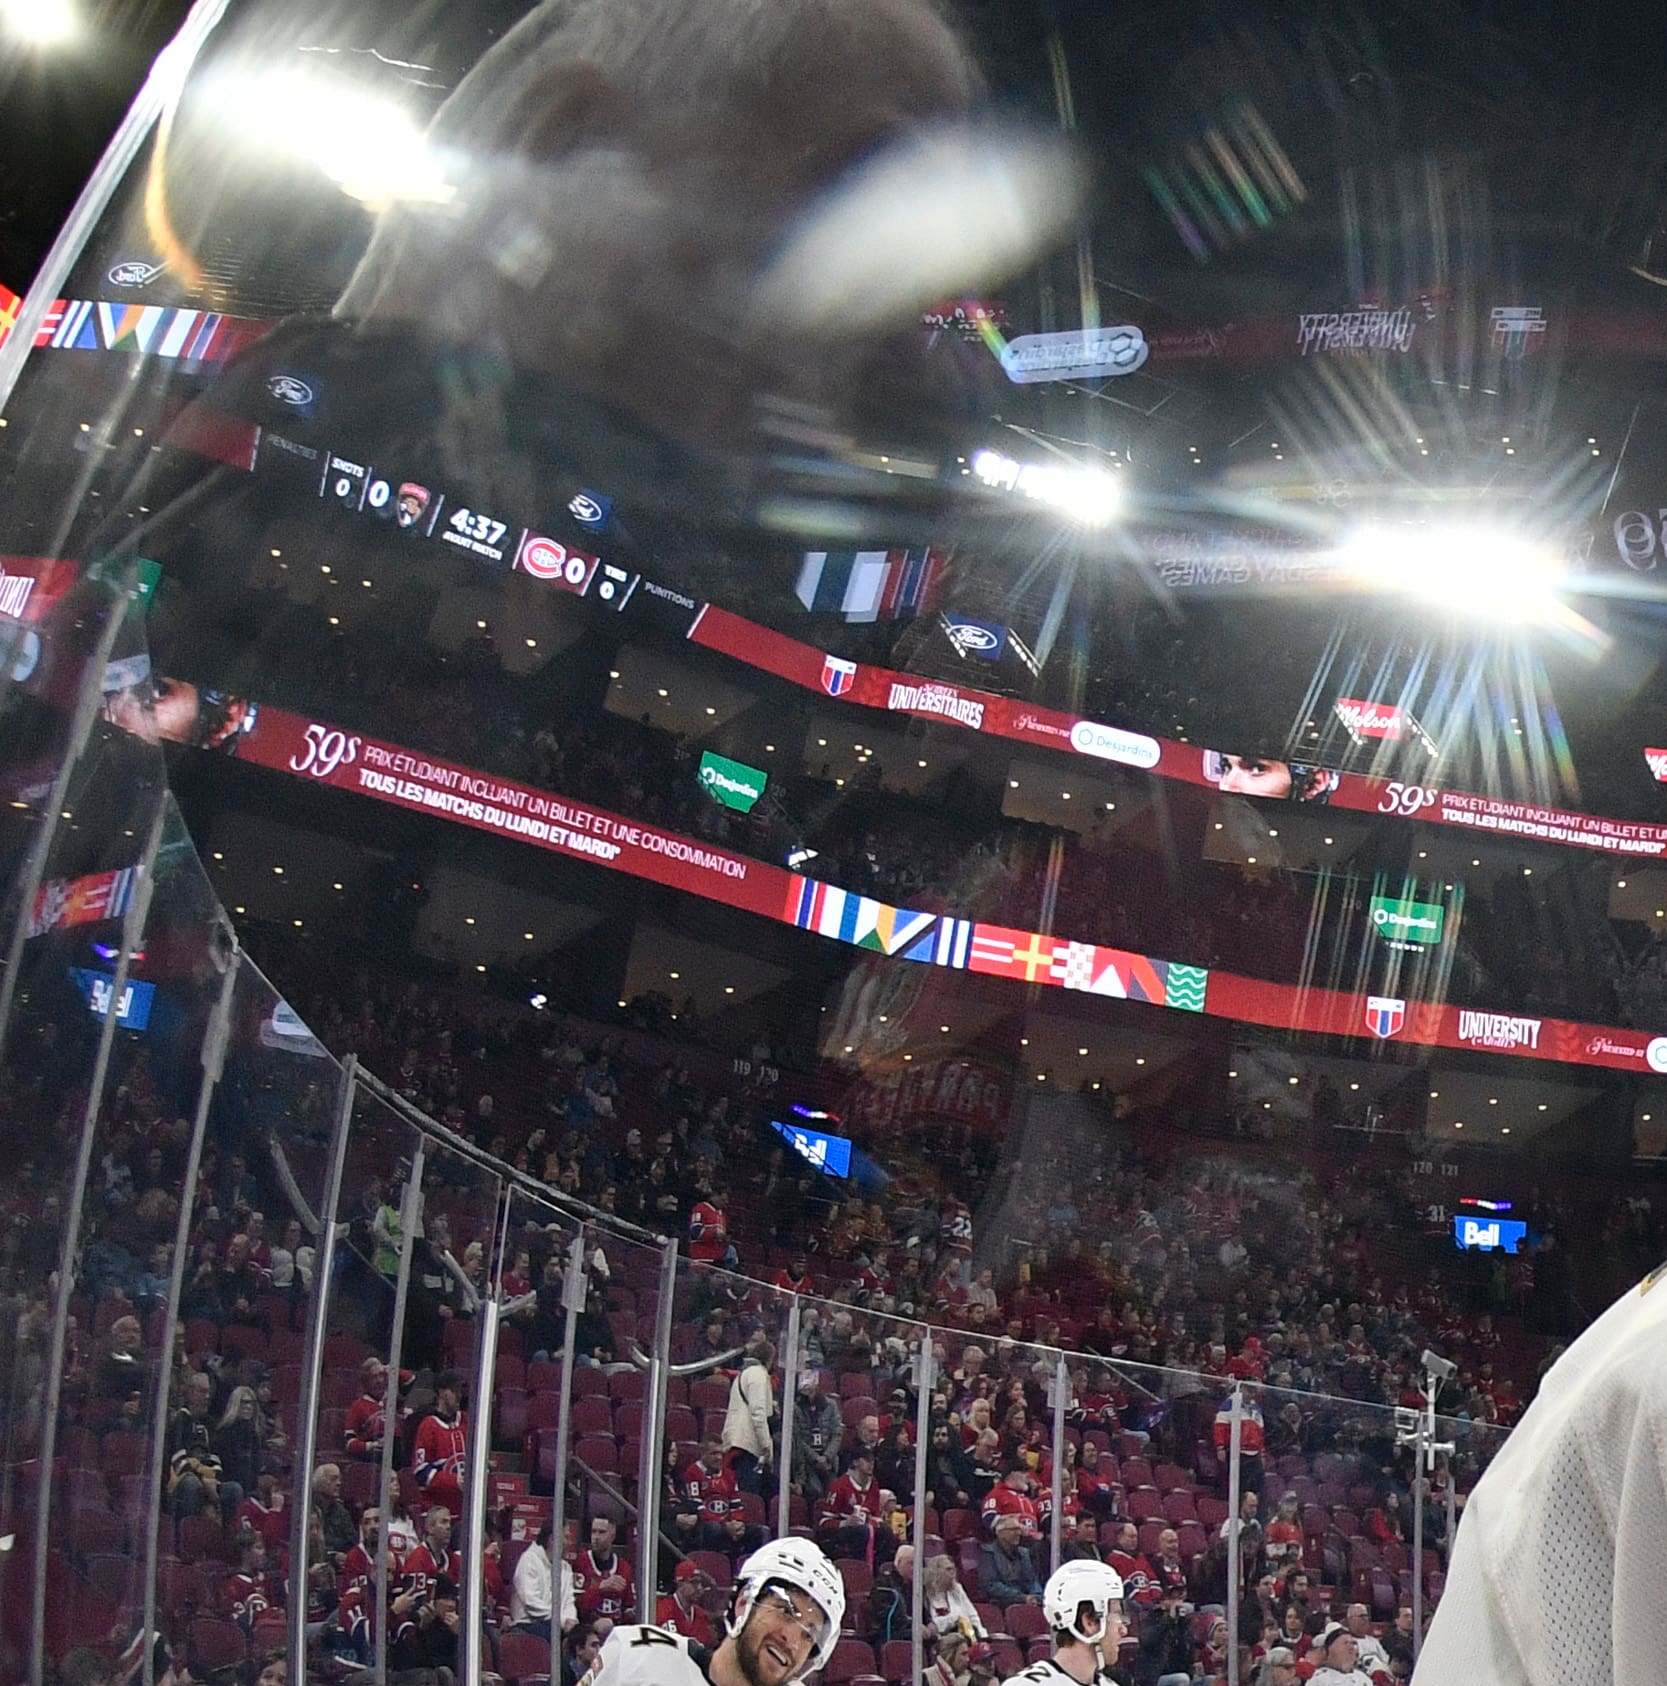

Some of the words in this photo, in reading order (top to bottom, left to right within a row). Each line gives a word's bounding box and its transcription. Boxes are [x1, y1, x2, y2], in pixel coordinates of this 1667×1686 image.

[331, 457, 364, 477] SHOTS
[335, 479, 350, 497] 0
[369, 481, 390, 507] 0
[450, 508, 508, 545] 4:37
[565, 557, 586, 584] 0
[600, 581, 615, 600] 0
[644, 581, 695, 609] PUNITIONS
[888, 683, 985, 730] UNIVERSITAIRES
[1096, 735, 1153, 759] Desjardins
[359, 768, 396, 793] TOUS
[396, 782, 425, 803] LES
[424, 788, 485, 820] MATCHS
[484, 806, 507, 826] DU
[506, 812, 549, 841] LUNDI
[547, 826, 569, 846] ET
[364, 745, 393, 769] PRIX
[460, 776, 527, 808] INCLUANT
[528, 797, 551, 817] UN
[550, 802, 595, 831] BILLET
[593, 817, 612, 835] ET
[613, 823, 642, 846] UNE
[641, 832, 748, 879] CONSOMMATION
[1442, 794, 1469, 809] PRIX
[1526, 806, 1583, 828] INCLUANT
[1583, 818, 1600, 832] UN
[1600, 821, 1639, 838] BILLET
[1639, 827, 1654, 840] ET
[1441, 808, 1475, 825] TOUS
[1474, 814, 1498, 829] LES
[1498, 818, 1548, 838] MATCHS
[1549, 825, 1568, 840] DU
[1567, 828, 1603, 847] LUNDI
[1603, 836, 1620, 849] ET
[1388, 911, 1437, 931] Desjardins
[1458, 1009, 1542, 1050] UNIVERSITY
[1464, 1221, 1500, 1246] Bell
[812, 1568, 839, 1595] CCM
